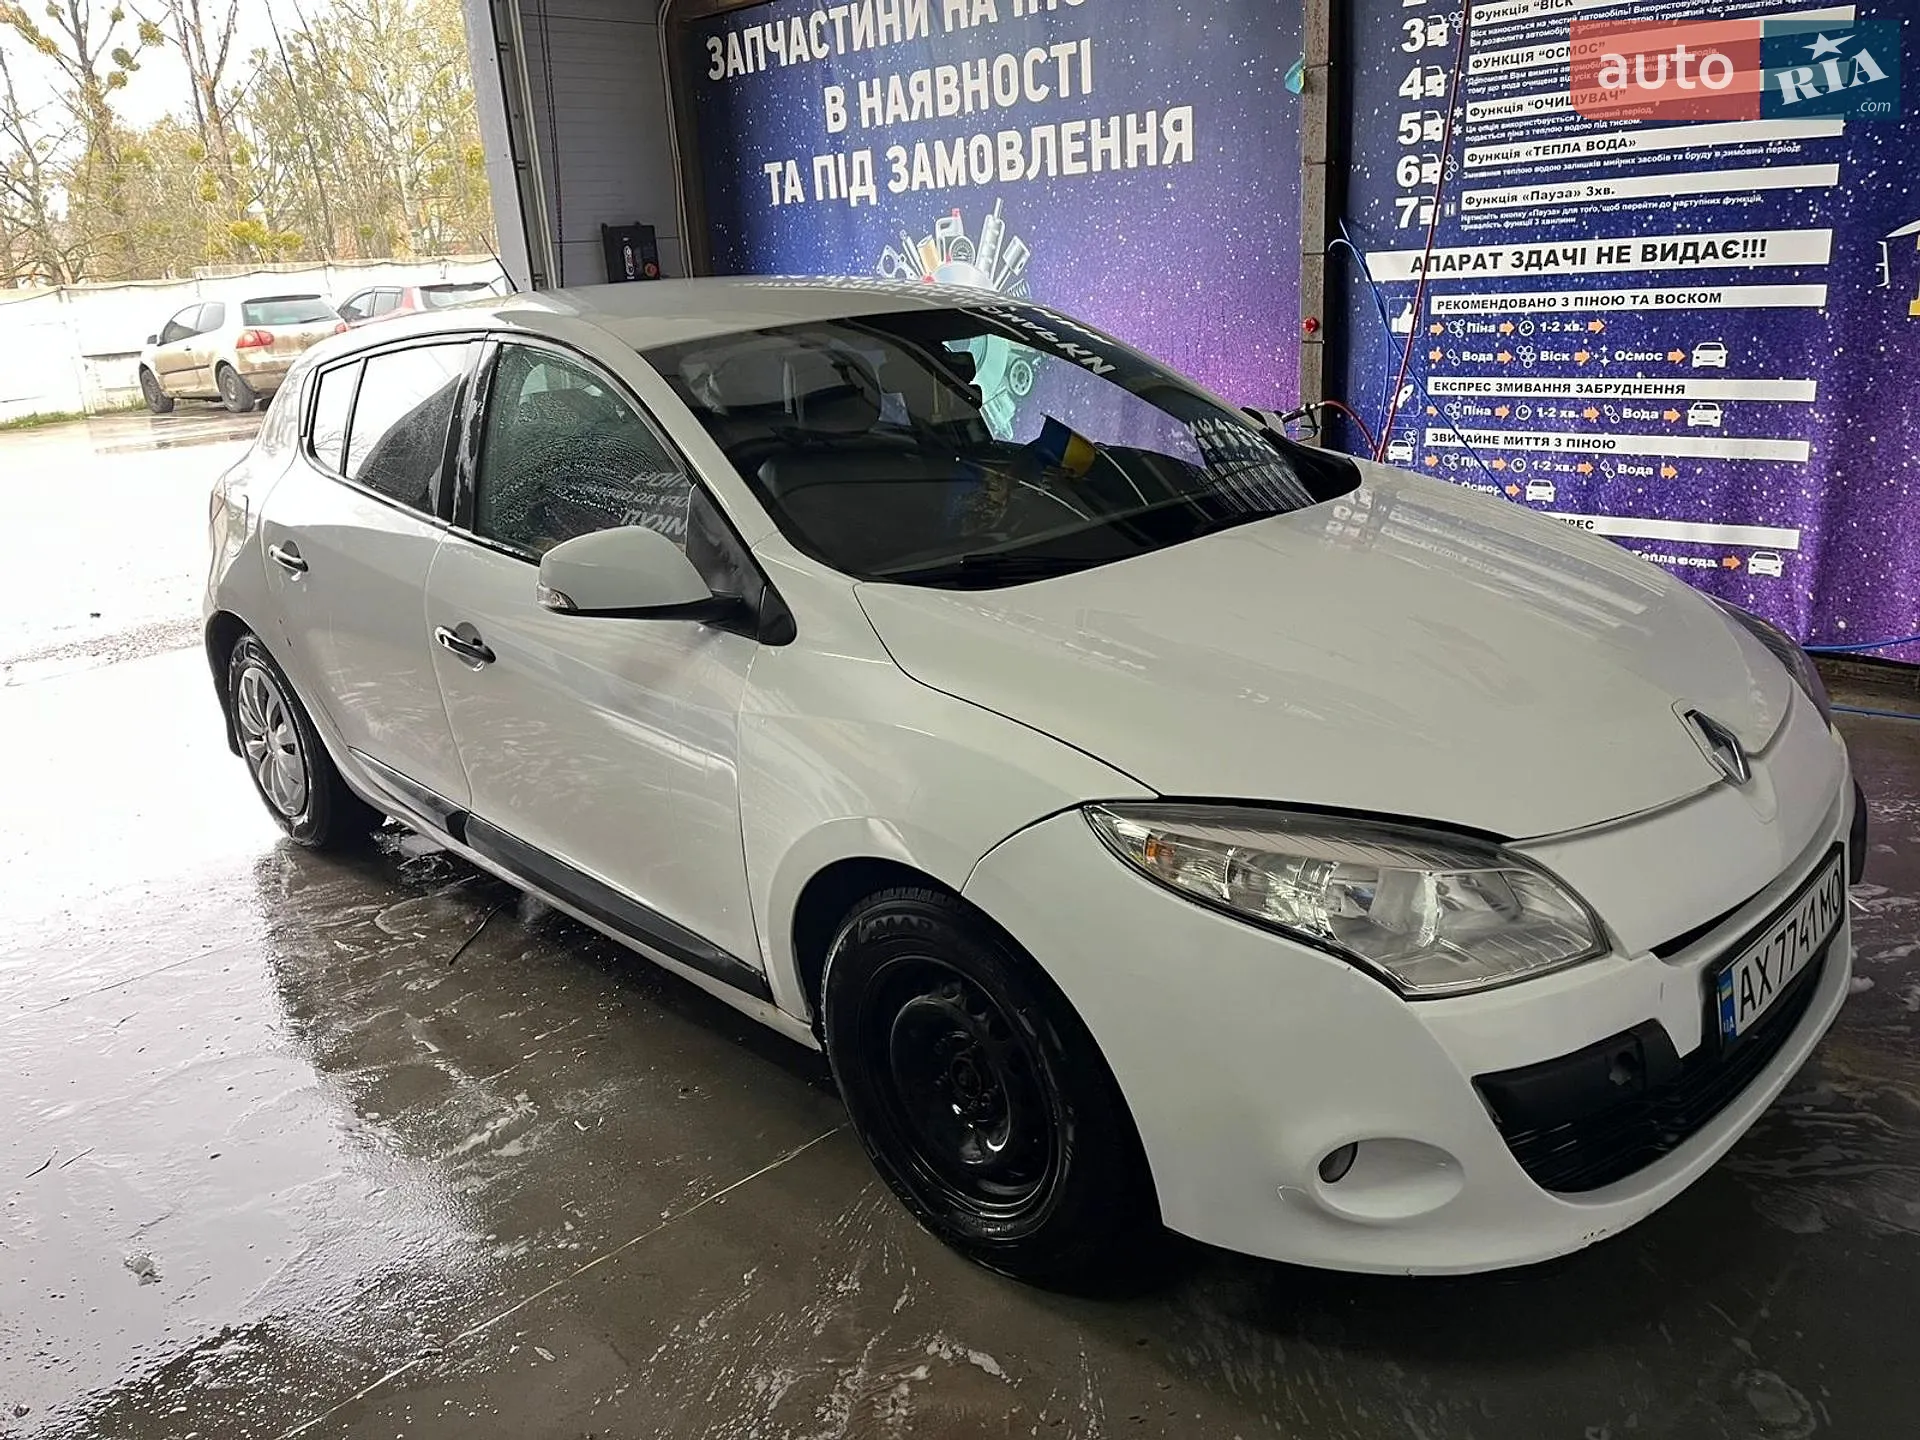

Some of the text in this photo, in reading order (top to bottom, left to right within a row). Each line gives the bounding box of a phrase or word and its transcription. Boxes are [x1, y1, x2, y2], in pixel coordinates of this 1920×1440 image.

[1474, 5, 1529, 21] Функція
[707, 0, 929, 81] ЗАПЧАСТИНИ
[1401, 18, 1425, 52] 3
[1472, 51, 1534, 69] ФУНКЦІЯ
[824, 38, 1093, 133] В НАЯВНОСТІ
[1399, 67, 1424, 100] 4
[1470, 103, 1523, 118] Функція
[1399, 111, 1421, 145] 5
[764, 105, 1194, 208] ТА ПІД ЗАМОВЛЕННЯ
[1467, 137, 1637, 164] Функція «ТЕПЛА ВОДА»
[1397, 155, 1420, 188] 6
[1465, 192, 1518, 208] Функція
[1522, 188, 1581, 203] «Пауза»
[1396, 197, 1418, 228] 7
[1410, 238, 1767, 275] АПАРАТ ЗДАЧІ НЕ ВИДАЄ!!!
[1437, 297, 1557, 312] РЕКОМЕНДОВАНО
[1576, 294, 1625, 308] ПІНОЮ
[1630, 294, 1650, 305] ТА
[1654, 292, 1722, 305] ВОСКОМ
[1467, 323, 1496, 334] Піна
[1540, 321, 1562, 333] 1-2
[1463, 350, 1663, 364] Вода Віск Осмос
[1434, 381, 1685, 396] ЕКСПРЕС ЗМИВАННЯ ЗАБРУДНЕННЯ
[1464, 405, 1491, 417] Піна
[1536, 408, 1557, 418] 1-2
[1623, 408, 1659, 421] Вода
[1504, 435, 1550, 448] МИТТЯ
[1567, 439, 1616, 450] ПІНОЮ
[1532, 460, 1551, 471] 1-2
[1618, 464, 1654, 476] Вода
[1774, 895, 1818, 985] 7741
